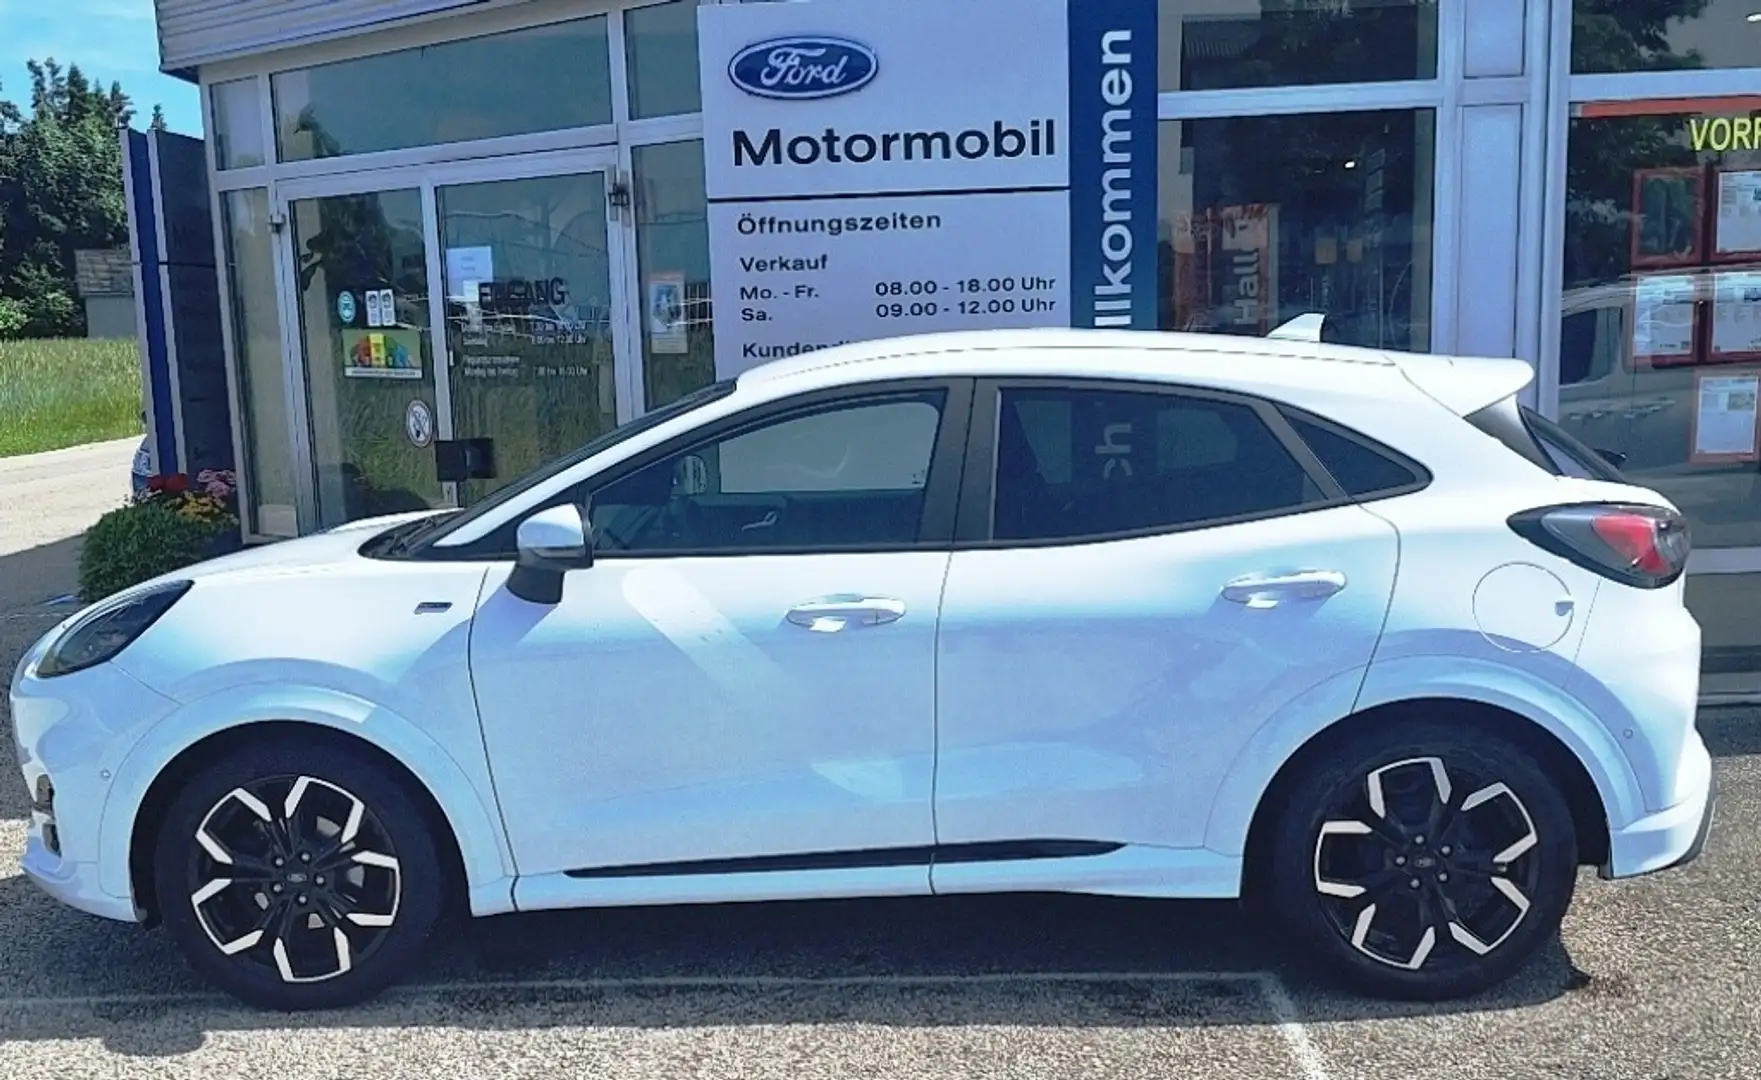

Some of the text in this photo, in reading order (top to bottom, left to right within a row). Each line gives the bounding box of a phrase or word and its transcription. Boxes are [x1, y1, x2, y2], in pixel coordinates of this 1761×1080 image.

[760, 47, 849, 87] Ford
[732, 119, 1055, 167] Motormobil
[737, 212, 941, 236] Öffnungszeiten
[739, 254, 828, 273] Verkauf
[740, 286, 778, 301] Mo.
[795, 284, 819, 299] Fr.
[875, 280, 938, 297] 08.00
[956, 277, 1015, 294] 18.00
[1021, 276, 1056, 291] Uhr
[741, 307, 773, 322] Sa.
[876, 302, 938, 318] 09.00
[957, 299, 1015, 315] 12.00
[1021, 297, 1056, 312] Uhr
